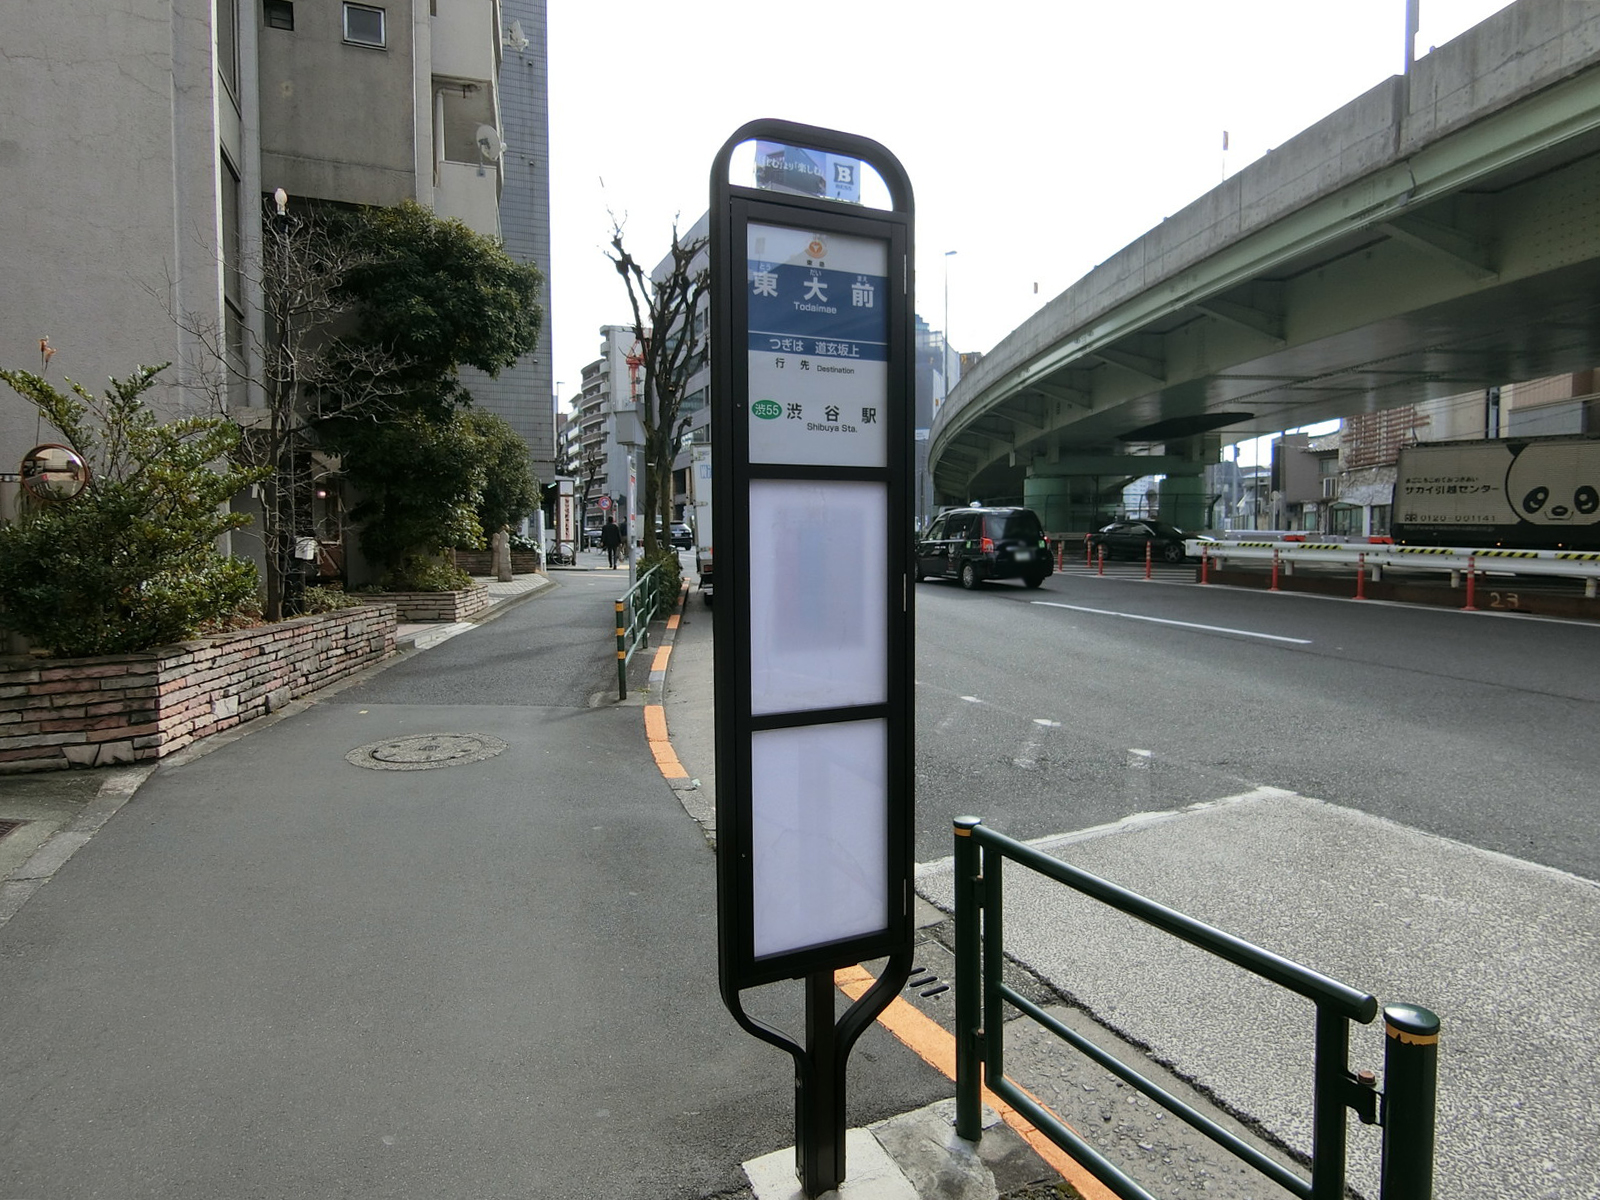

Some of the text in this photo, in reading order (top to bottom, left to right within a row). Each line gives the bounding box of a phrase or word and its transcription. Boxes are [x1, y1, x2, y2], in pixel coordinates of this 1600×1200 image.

[838, 166, 851, 182] B
[753, 271, 875, 308] 東大前
[794, 302, 837, 314] Todaimae
[769, 339, 860, 357] つぎは 道玄坂上
[775, 357, 810, 371] 行先
[817, 365, 855, 375] Destination
[755, 403, 780, 416] 渋55
[787, 402, 877, 424] 渋谷駅
[807, 423, 858, 433] Shibuya Sta.
[1405, 485, 1499, 495] サカイ引越センター
